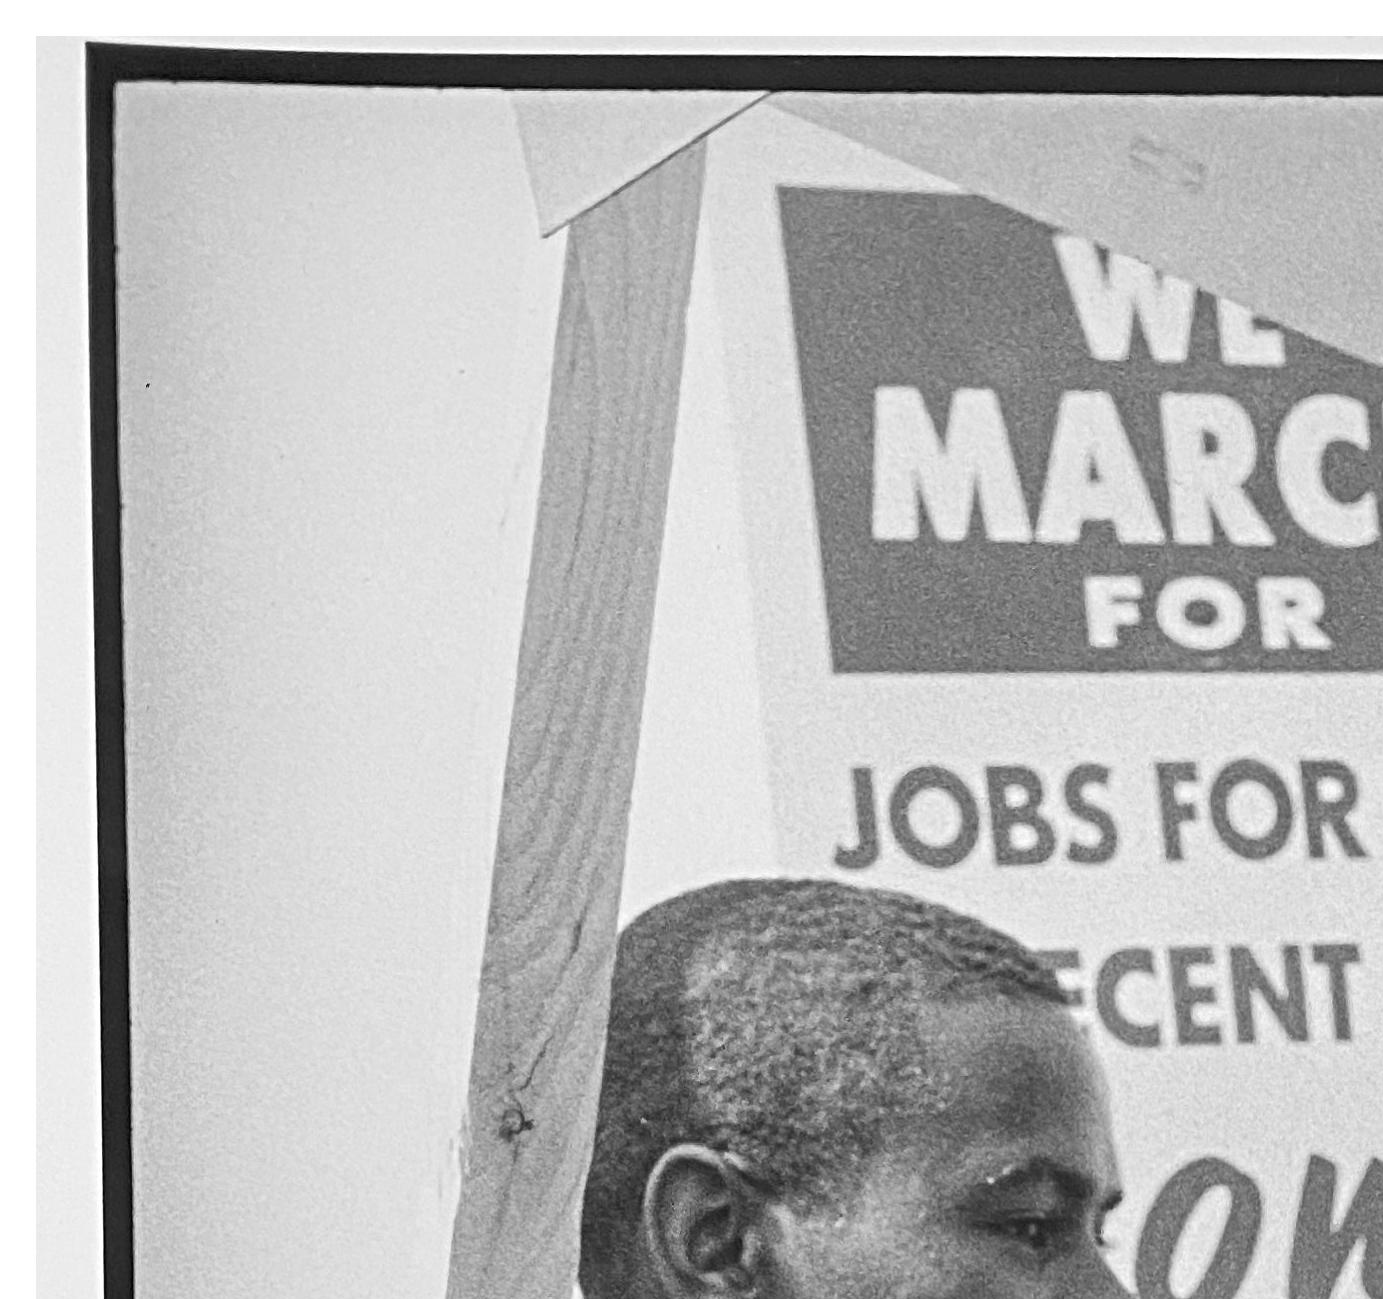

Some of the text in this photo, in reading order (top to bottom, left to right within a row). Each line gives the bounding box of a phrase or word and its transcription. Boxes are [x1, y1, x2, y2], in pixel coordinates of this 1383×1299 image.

[1084, 575, 1331, 650] FOR
[833, 763, 1119, 870] JOBS
[1154, 757, 1368, 862] FOR
[1040, 942, 1361, 1049] CENT
